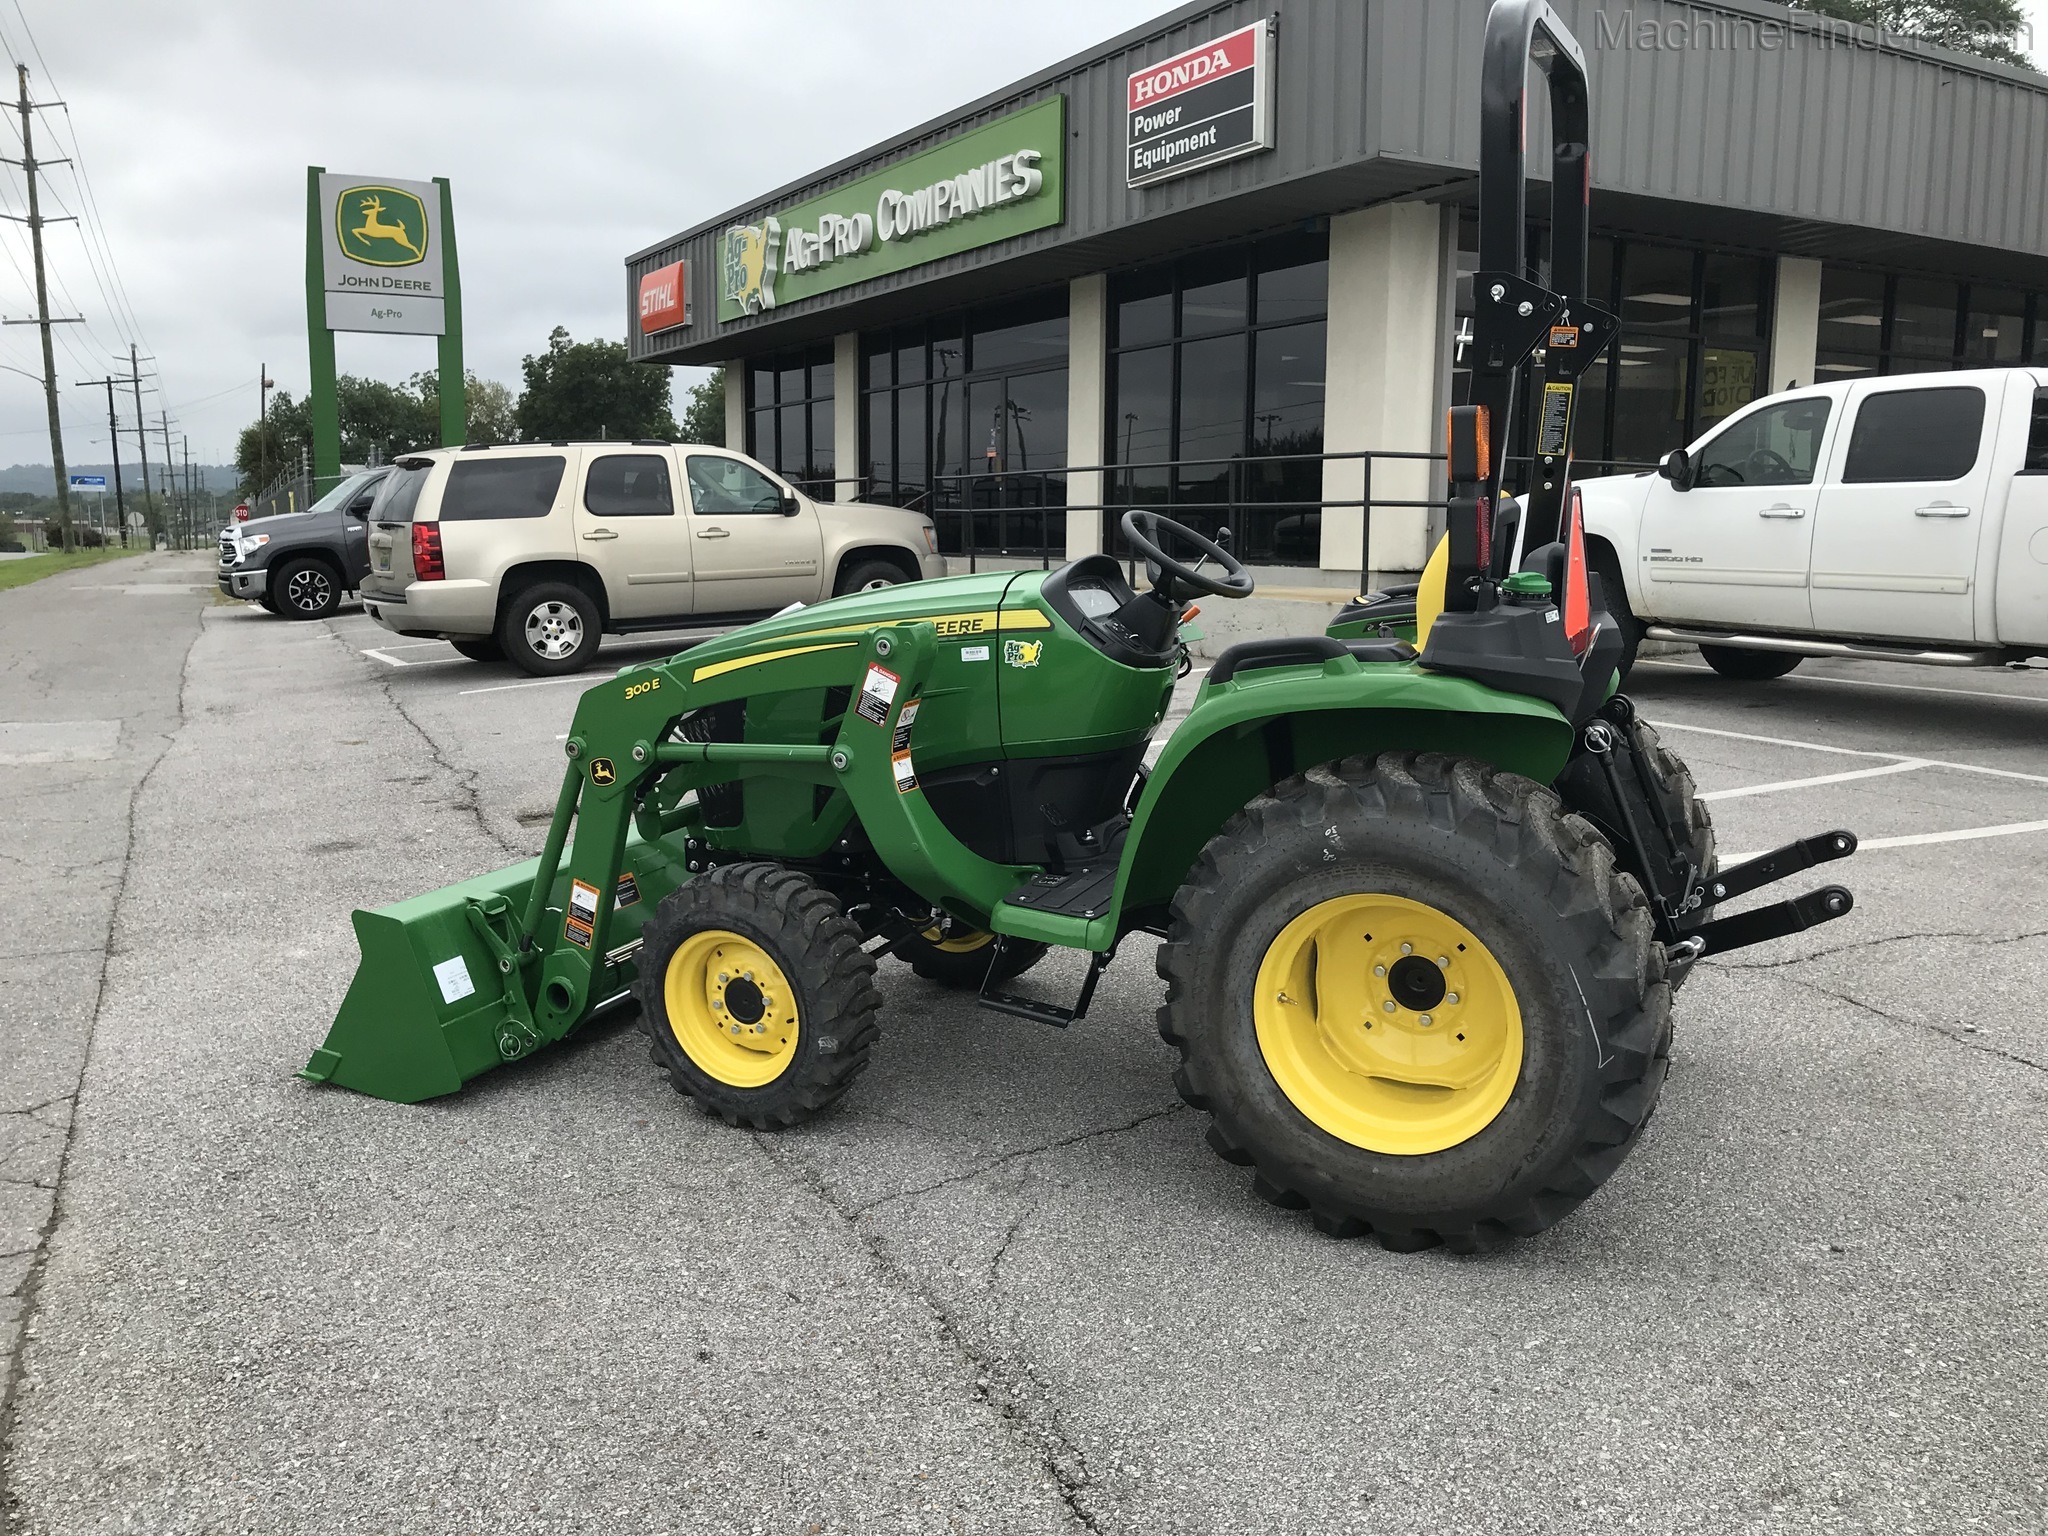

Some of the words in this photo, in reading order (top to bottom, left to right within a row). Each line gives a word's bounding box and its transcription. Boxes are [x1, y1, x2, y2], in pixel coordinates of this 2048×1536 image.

[1135, 49, 1231, 103] HONDA
[1134, 106, 1182, 137] Power
[1134, 125, 1217, 170] Equipment
[338, 274, 380, 288] JOHN
[382, 276, 432, 291] DEERE
[726, 263, 748, 296] Pro
[641, 282, 675, 317] STIHL
[370, 308, 403, 320] Ag-Pro
[235, 509, 248, 517] STO
[935, 618, 984, 634] EERE
[1007, 652, 1025, 662] Pro
[625, 681, 651, 700] 300
